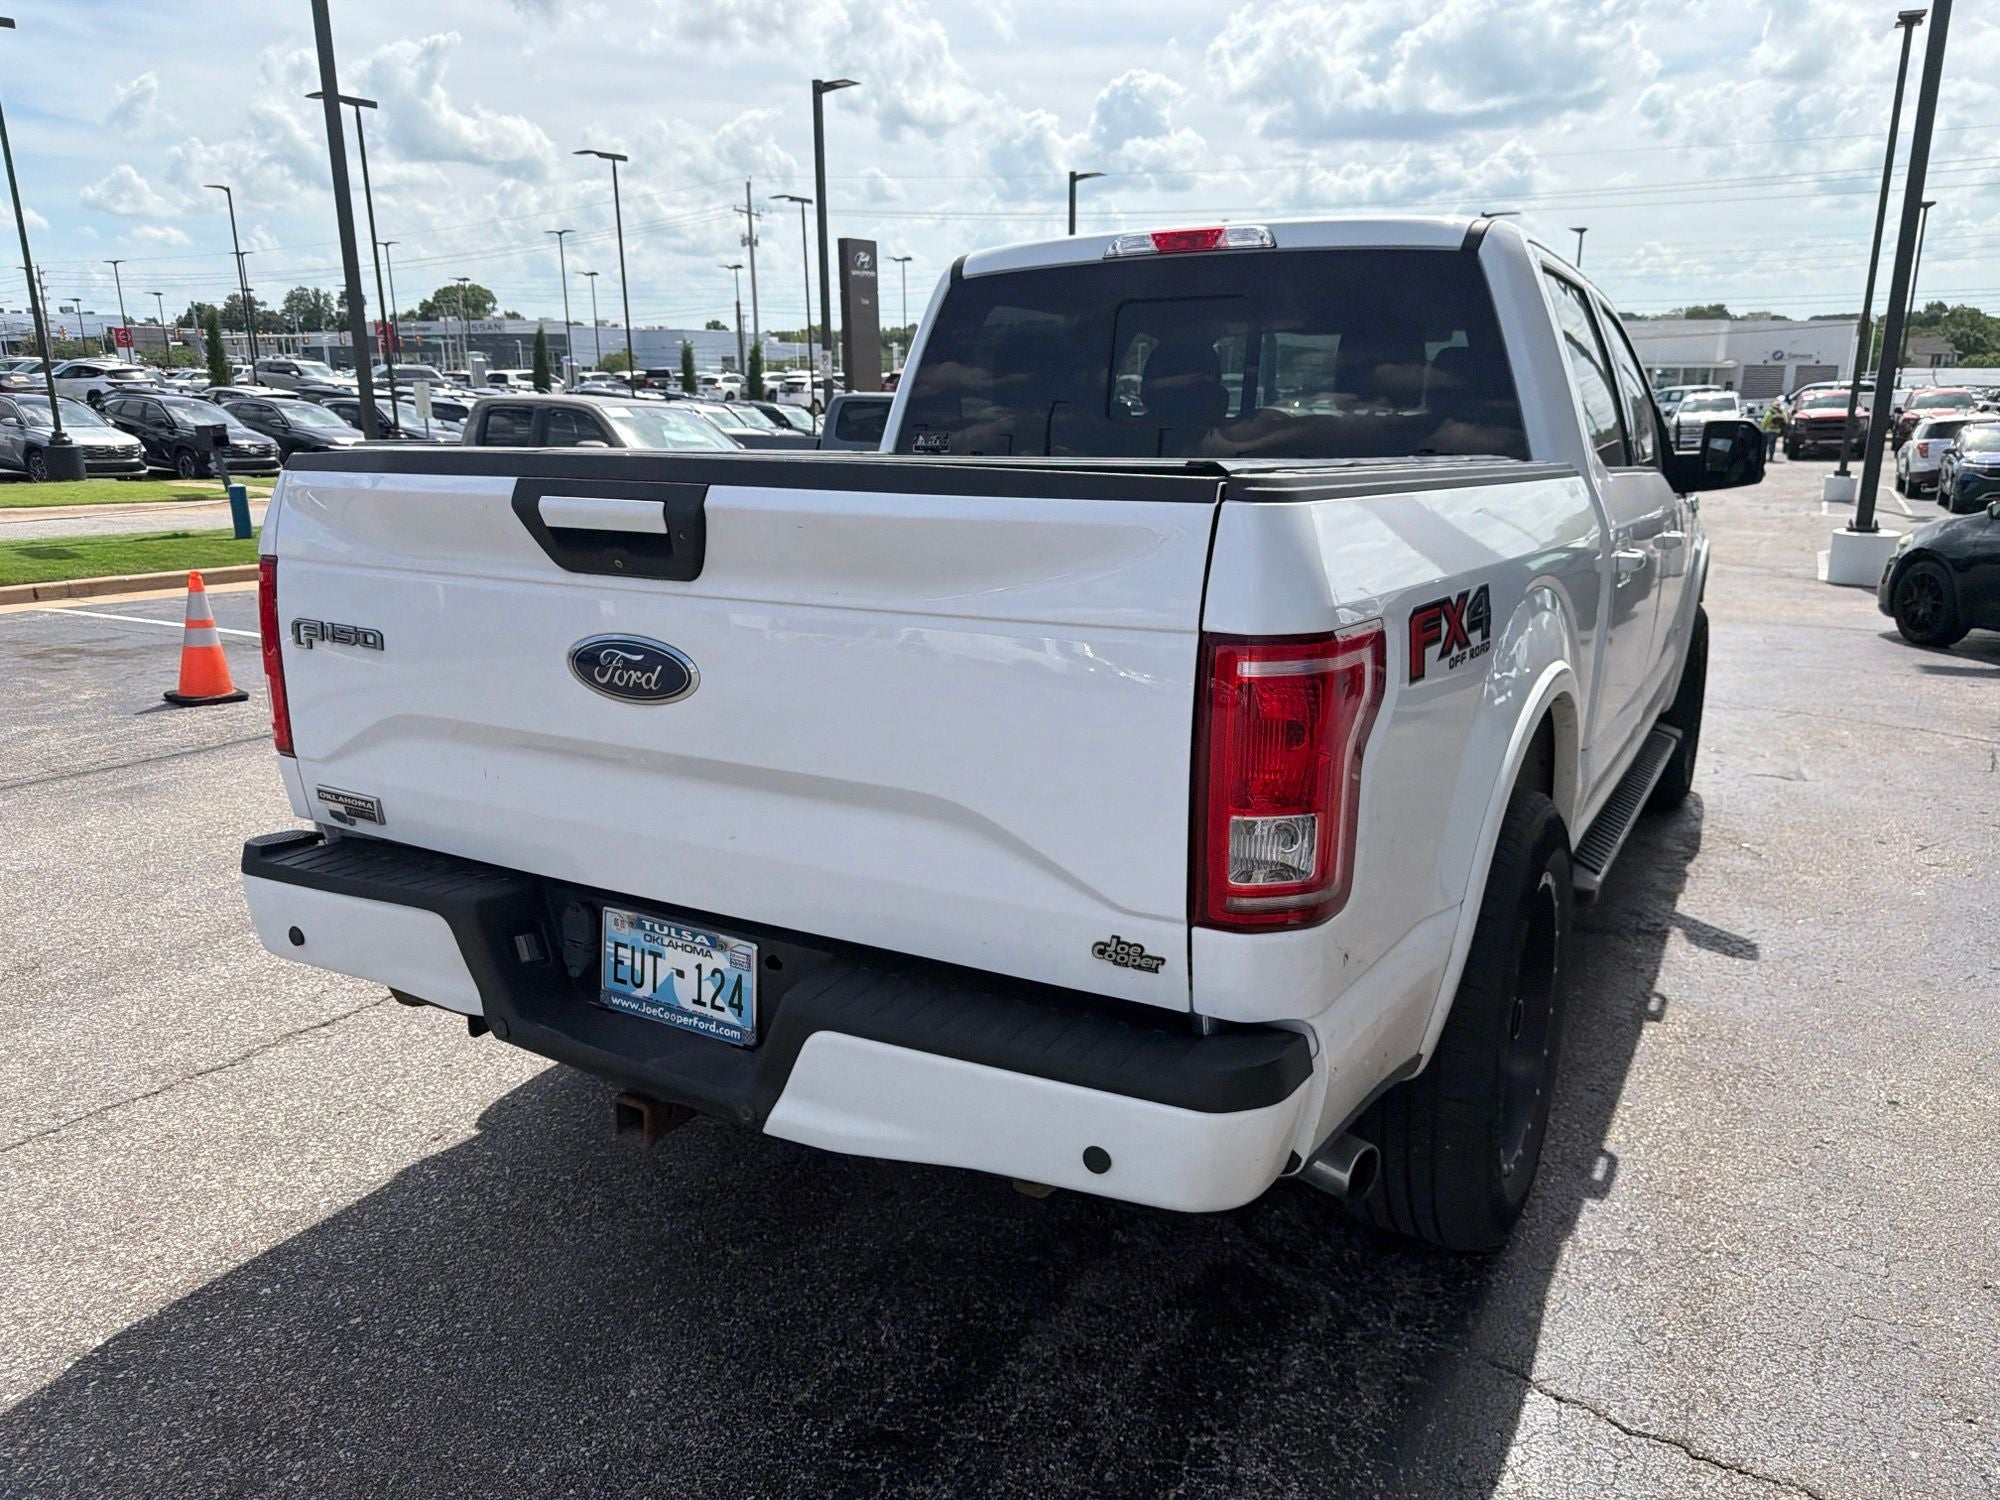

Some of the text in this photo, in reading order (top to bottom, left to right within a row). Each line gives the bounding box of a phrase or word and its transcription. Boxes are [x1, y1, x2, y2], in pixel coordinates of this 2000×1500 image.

[1408, 583, 1491, 687] FX4
[594, 648, 662, 690] Ford
[1448, 640, 1491, 670] OFF ROAD
[319, 791, 374, 810] OKLAHOMA
[641, 919, 711, 947] TULSA
[643, 932, 714, 960] OKLAHOMA
[1105, 936, 1143, 956] Joe
[1092, 943, 1163, 969] Cooper
[611, 995, 741, 1040] www.JoeCooperFord.com
